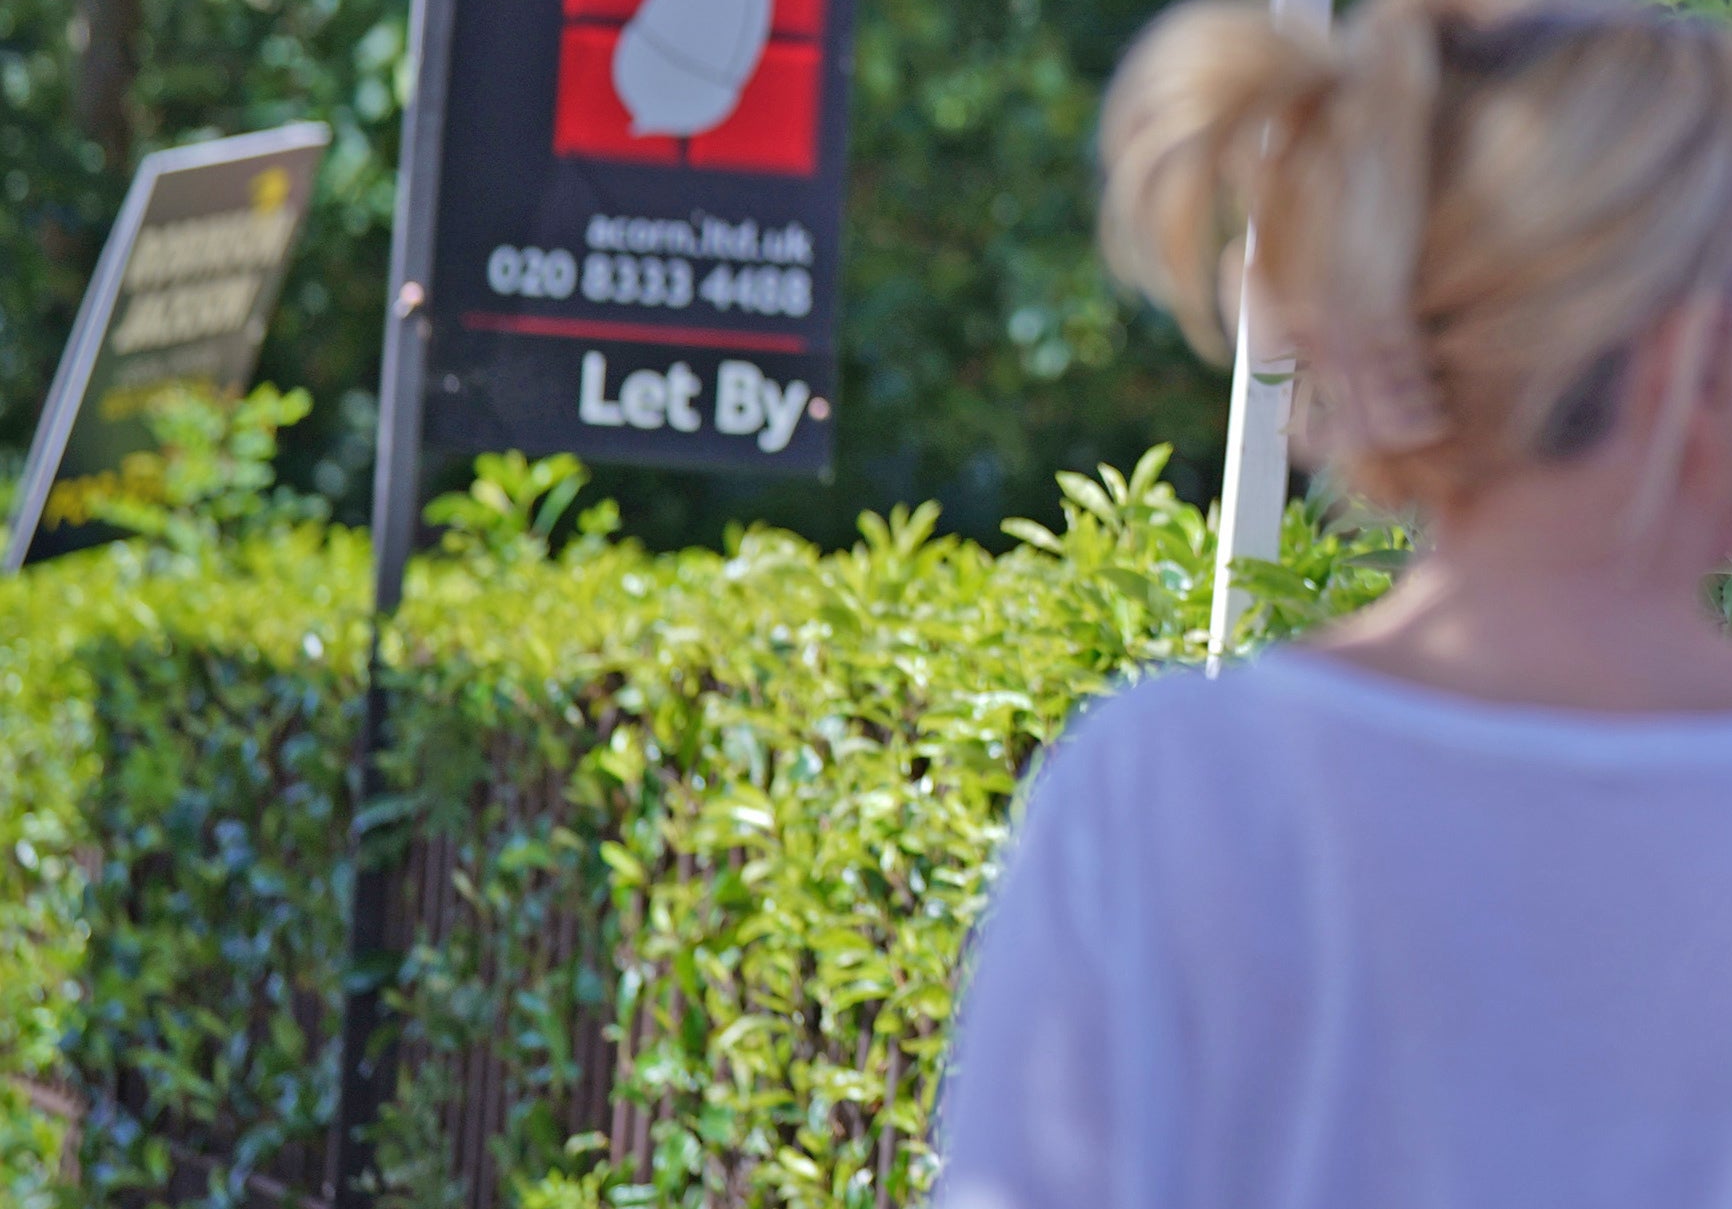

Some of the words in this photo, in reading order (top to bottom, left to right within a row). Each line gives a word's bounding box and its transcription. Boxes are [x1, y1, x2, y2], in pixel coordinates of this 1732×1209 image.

[487, 244, 578, 300] 020
[579, 349, 702, 433] Let
[714, 359, 811, 454] By
